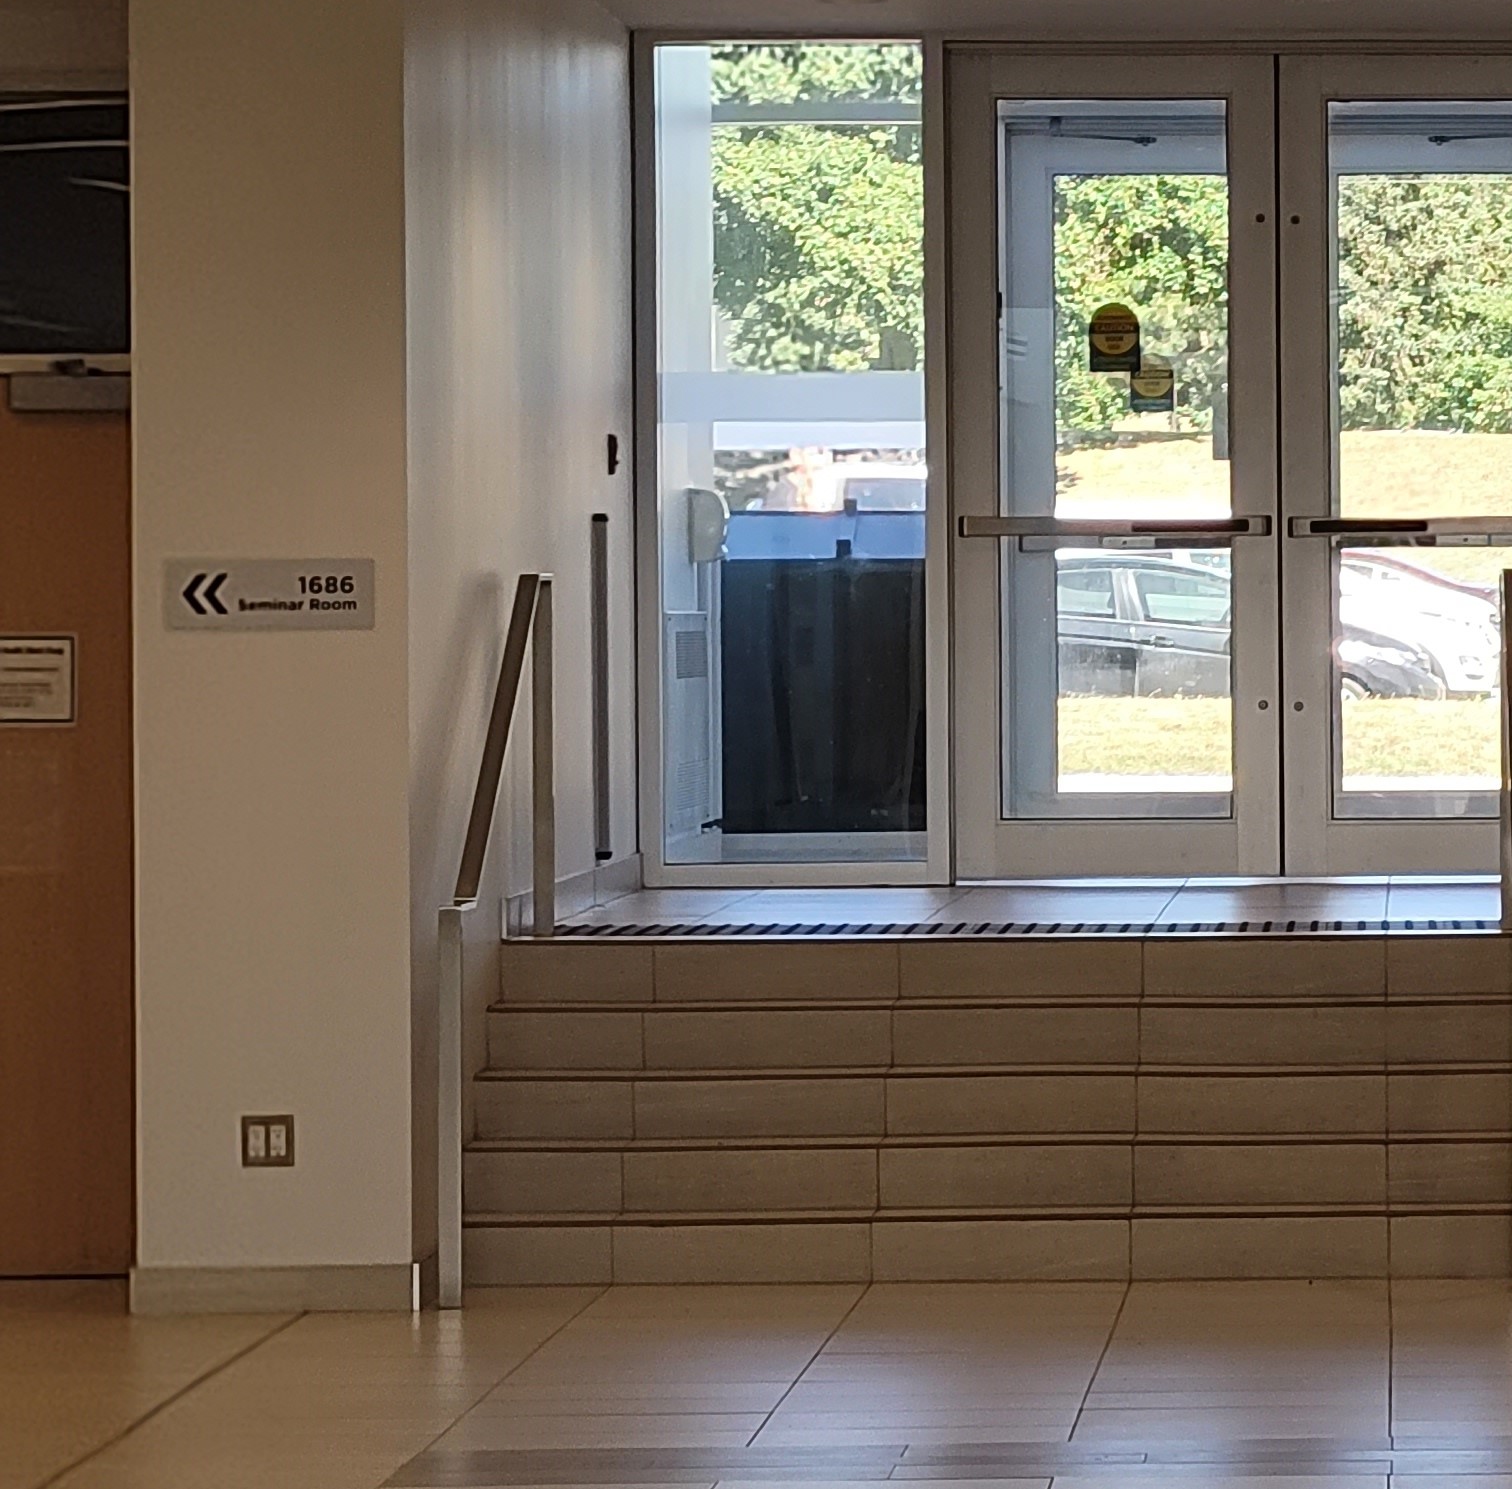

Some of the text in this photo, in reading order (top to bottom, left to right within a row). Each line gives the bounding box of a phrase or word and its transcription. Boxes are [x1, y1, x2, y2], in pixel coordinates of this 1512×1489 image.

[298, 575, 354, 595] 1686
[238, 598, 357, 612] Seminar Room
